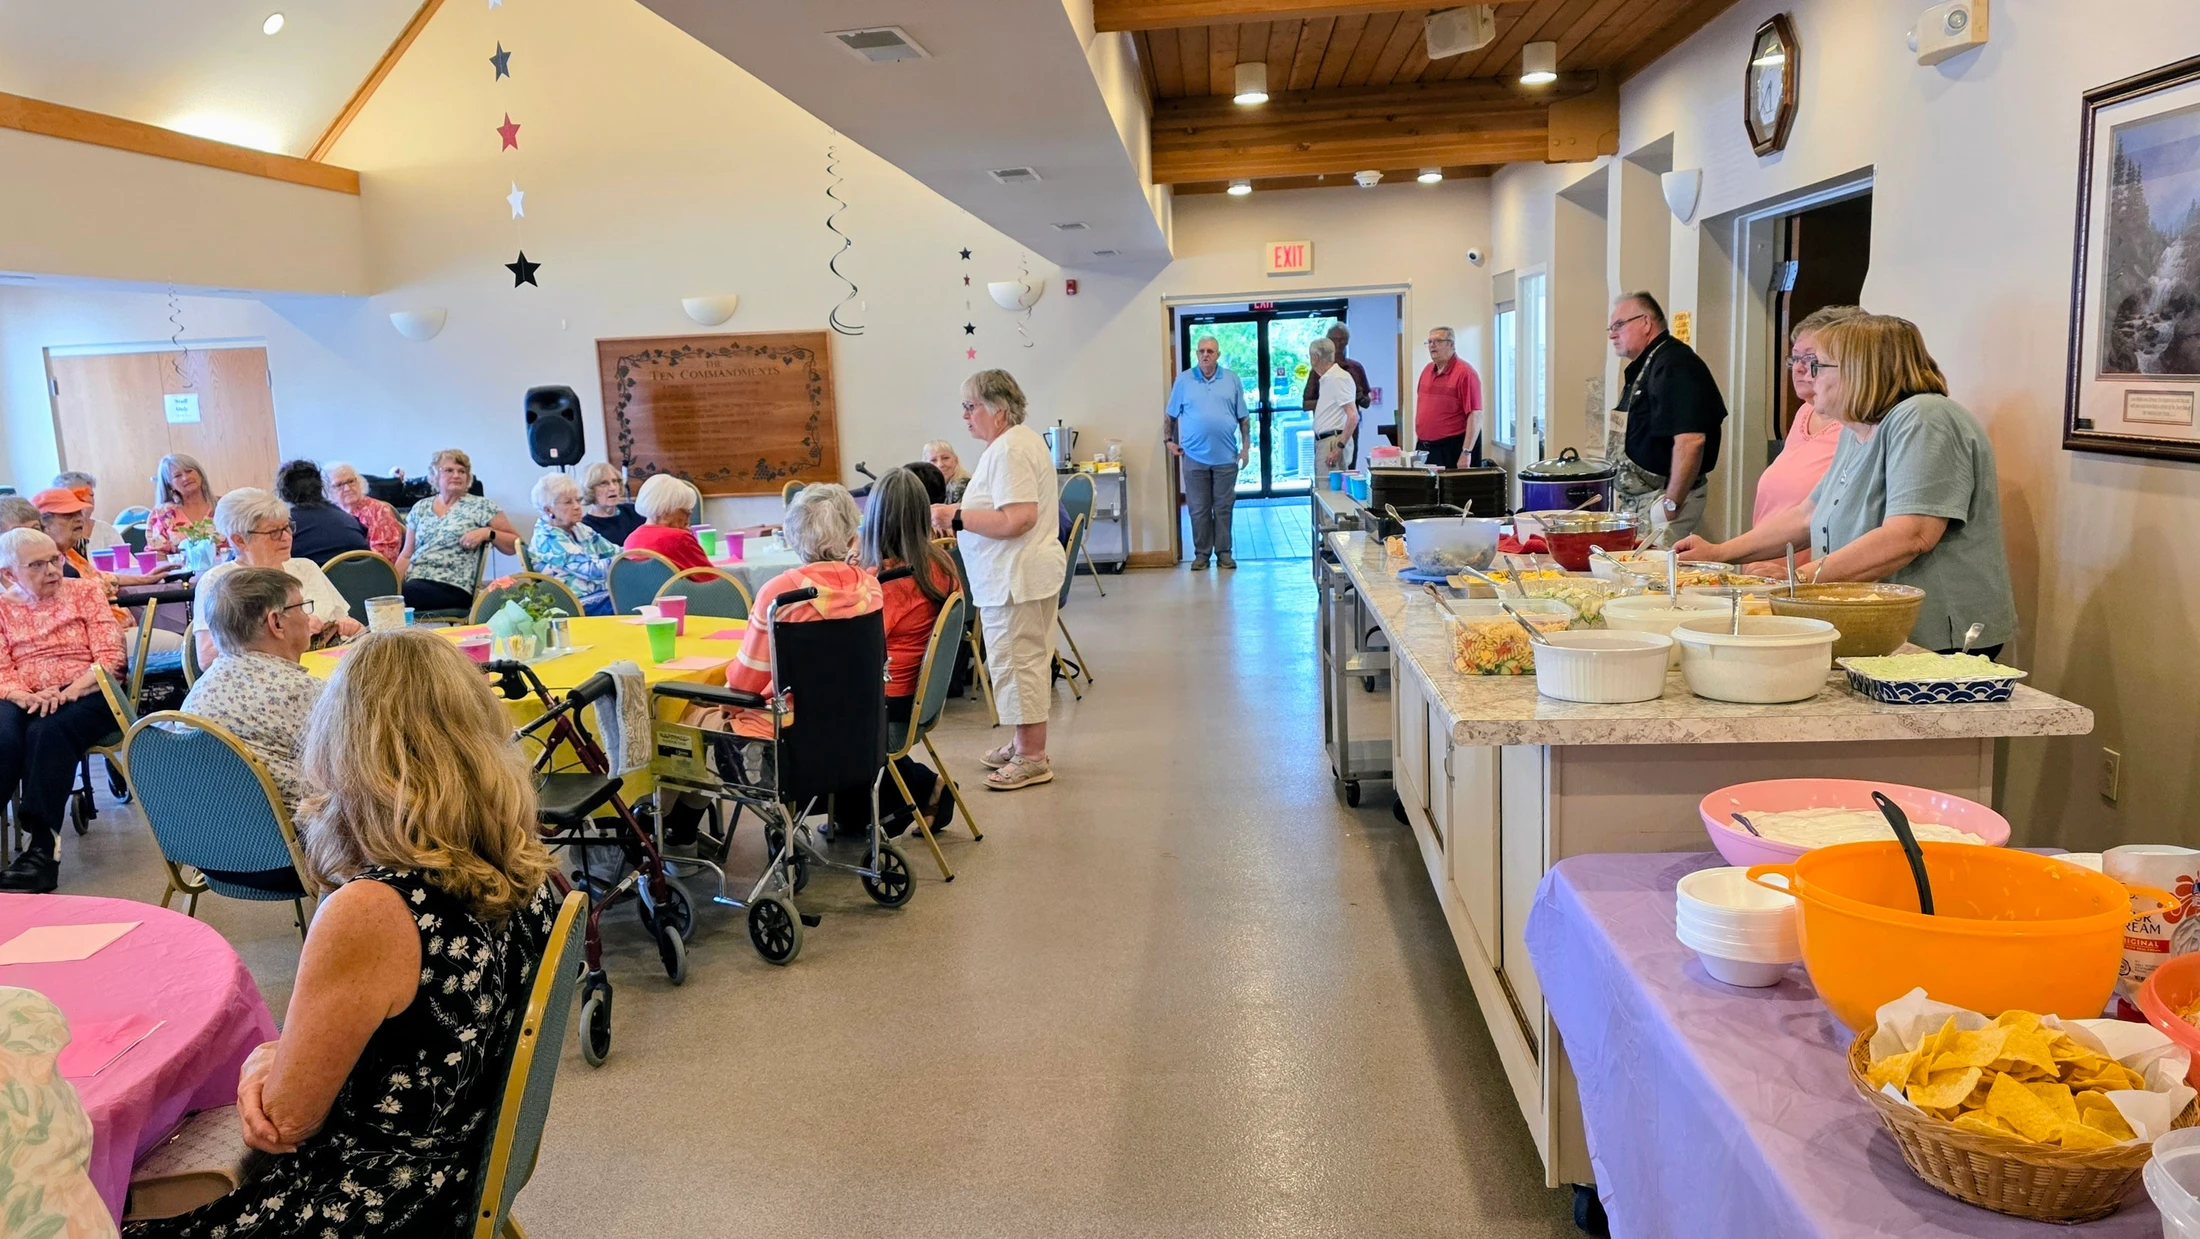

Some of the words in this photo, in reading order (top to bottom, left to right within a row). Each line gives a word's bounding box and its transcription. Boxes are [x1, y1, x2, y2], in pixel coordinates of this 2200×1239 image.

[1274, 244, 1304, 268] EXIT
[705, 360, 721, 368] THE
[650, 370, 675, 381] TEN
[680, 366, 780, 379] COMMANDMENTS
[2125, 921, 2161, 935] REAM
[2124, 937, 2160, 948] IGINAL
